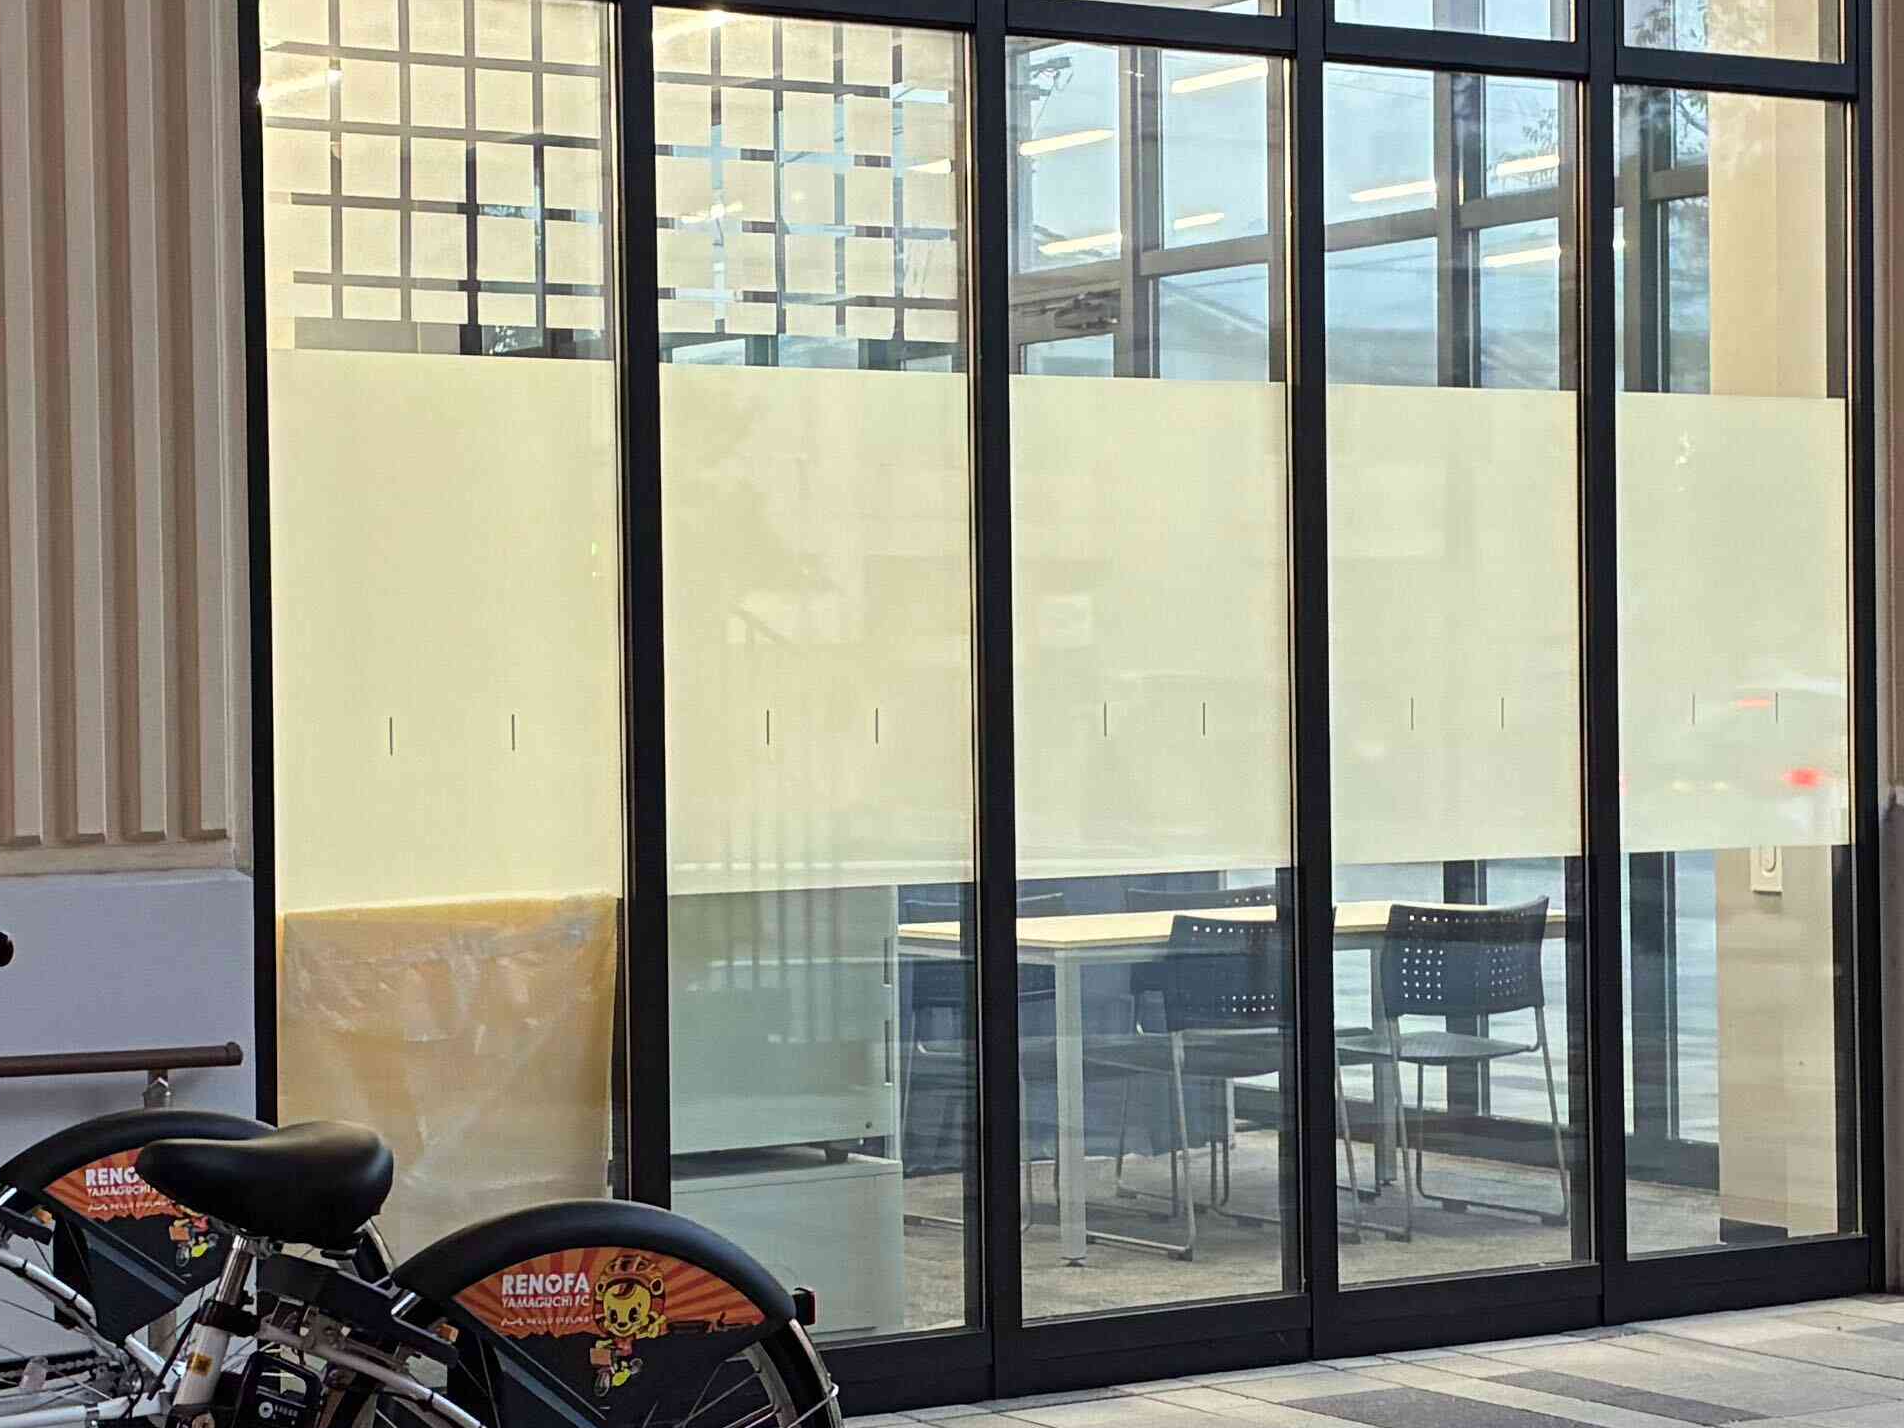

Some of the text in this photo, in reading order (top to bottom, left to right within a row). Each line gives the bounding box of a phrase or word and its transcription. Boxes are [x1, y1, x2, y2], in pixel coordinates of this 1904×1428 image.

[85, 1166, 141, 1187] RENO
[501, 1272, 590, 1296] RENOFA
[501, 1295, 573, 1309] YAMAGUCHI
